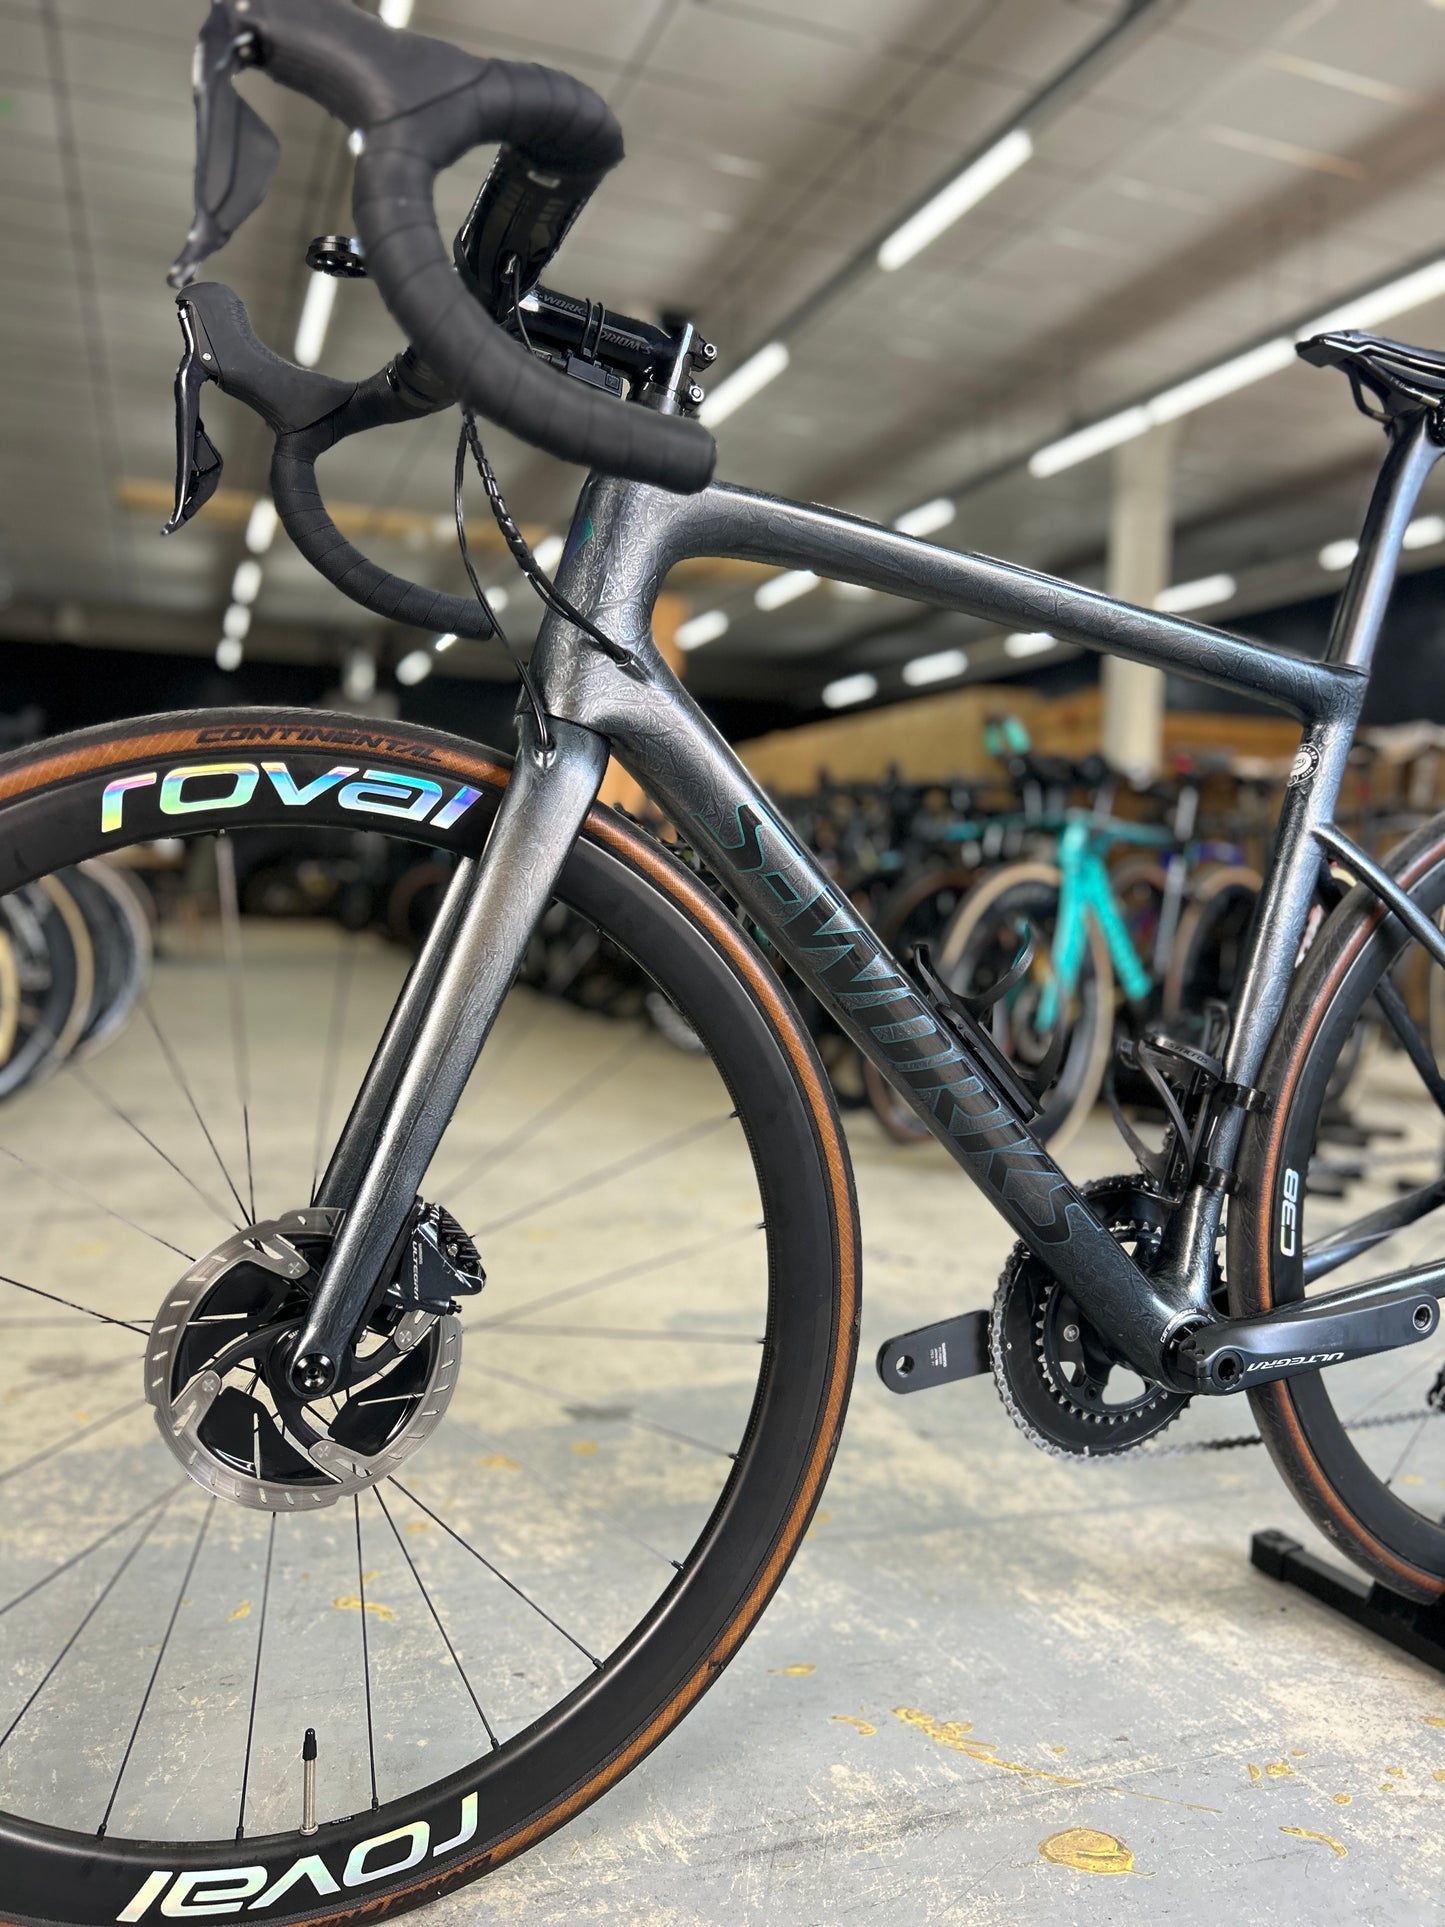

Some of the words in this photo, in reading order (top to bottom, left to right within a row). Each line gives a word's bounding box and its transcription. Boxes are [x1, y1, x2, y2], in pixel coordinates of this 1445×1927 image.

[531, 289, 588, 316] S-WORK
[196, 727, 441, 762] CONTINENTAL
[101, 762, 483, 833] roval
[690, 799, 1104, 1245] S-WORKS
[1280, 1168, 1299, 1257] C38
[1246, 1352, 1345, 1372] ULTEGRA
[115, 1791, 478, 1922] roval
